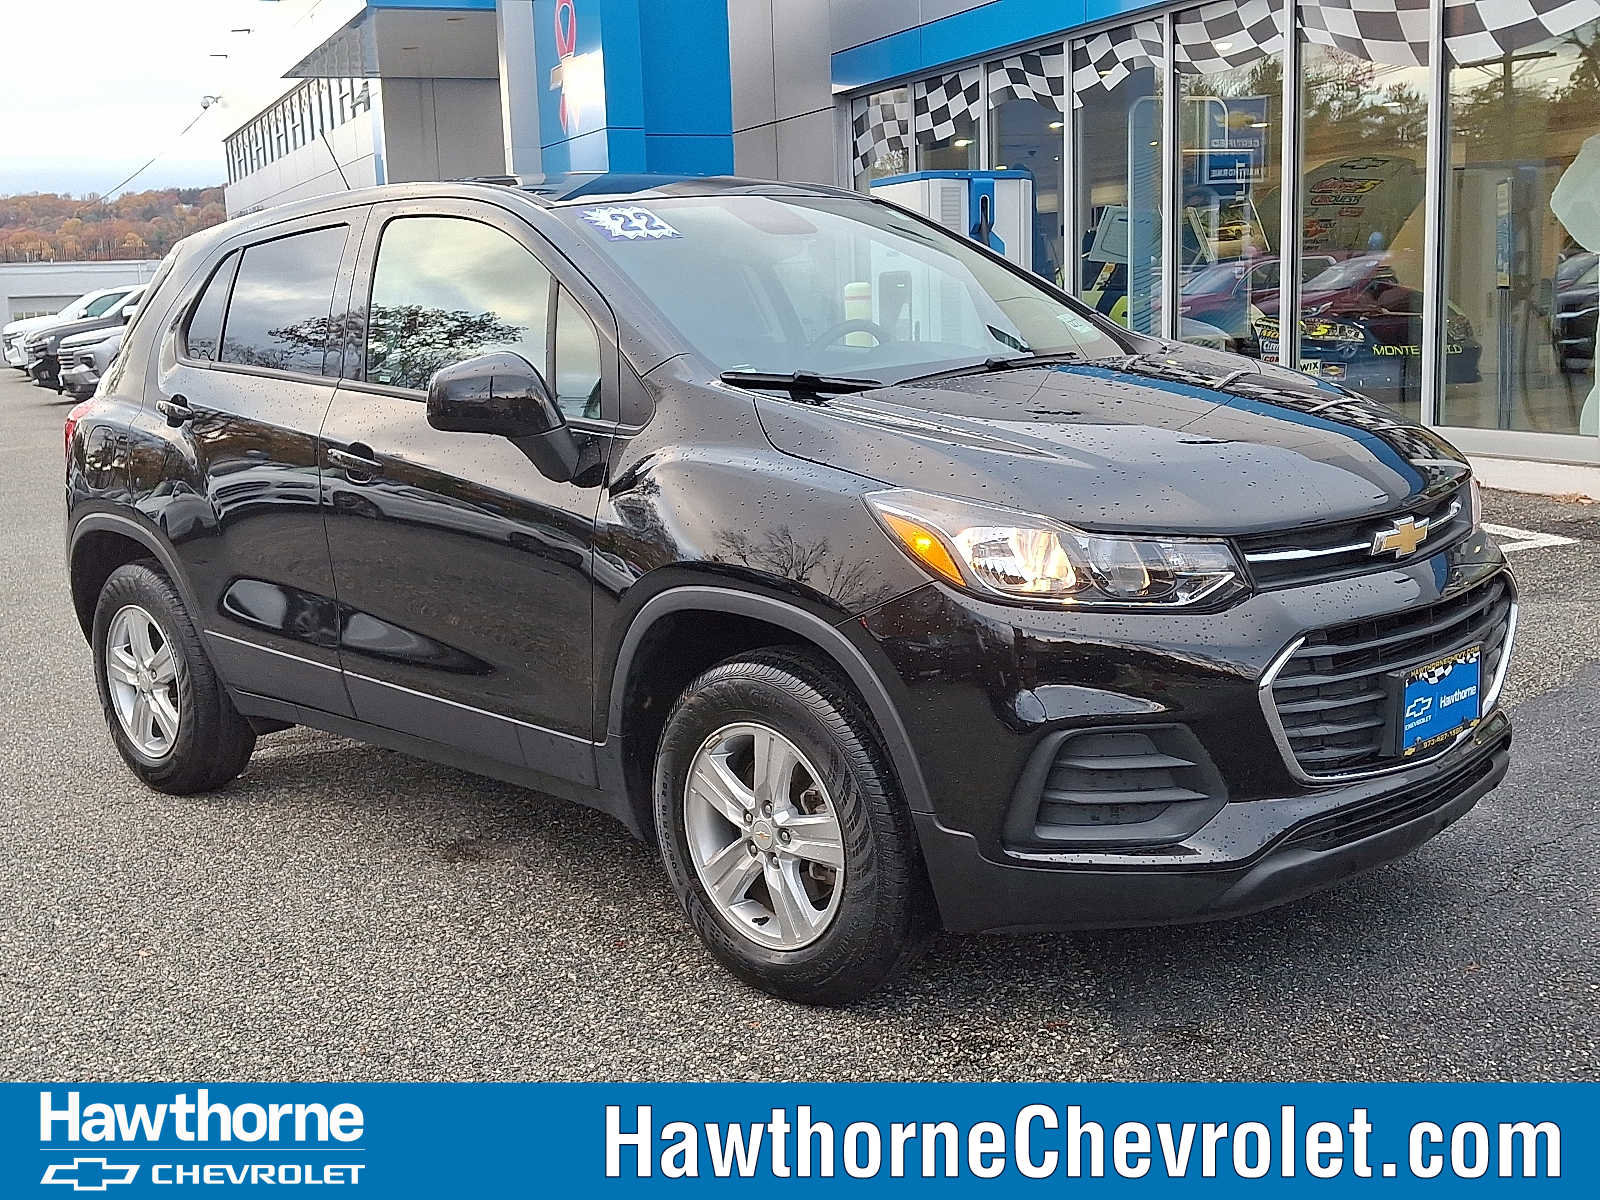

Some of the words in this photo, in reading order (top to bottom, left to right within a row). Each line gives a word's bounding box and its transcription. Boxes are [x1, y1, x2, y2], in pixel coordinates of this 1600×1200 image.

[609, 212, 667, 232] 22
[1372, 344, 1420, 355] MONTE
[1300, 362, 1319, 372] WIX
[1439, 685, 1477, 709] Hawthorne
